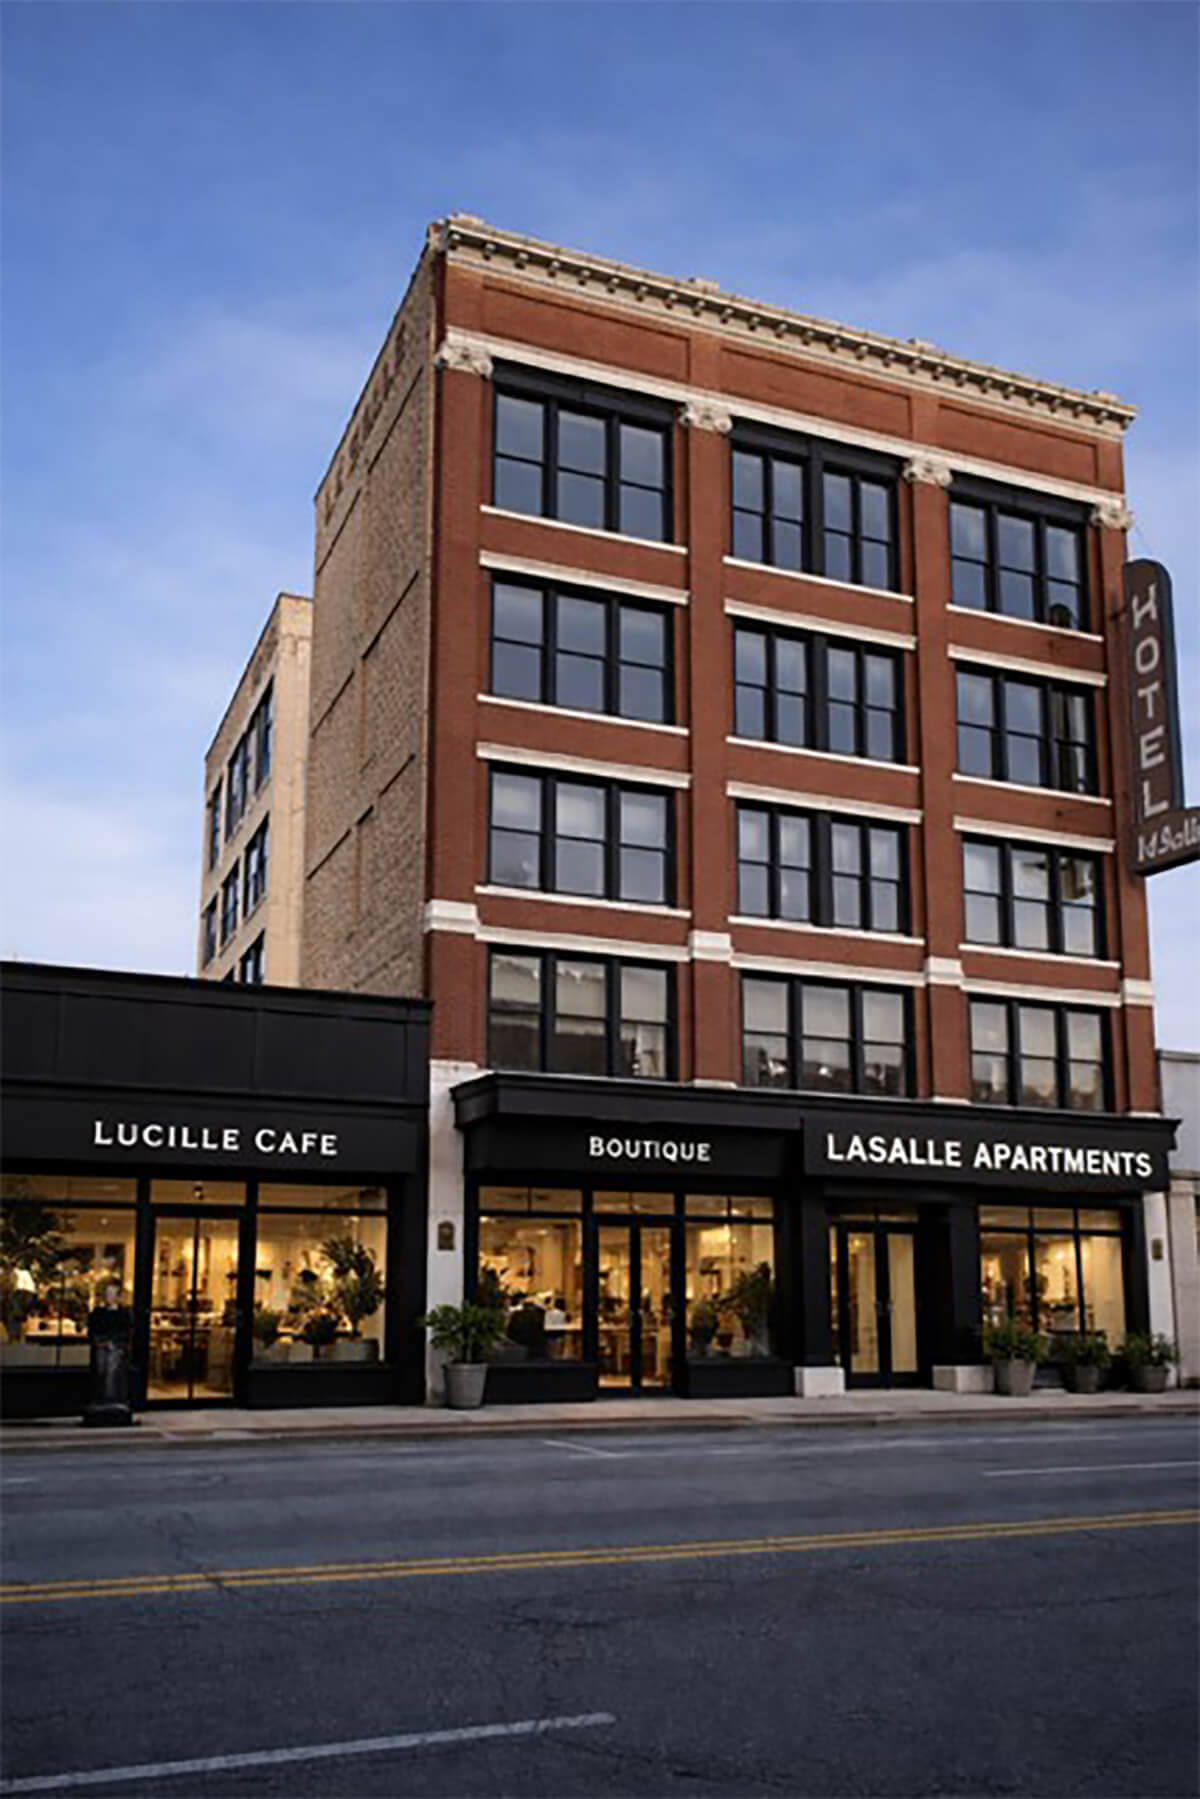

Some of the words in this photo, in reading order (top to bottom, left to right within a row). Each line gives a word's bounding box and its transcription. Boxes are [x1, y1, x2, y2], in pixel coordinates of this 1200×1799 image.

[1132, 583, 1169, 818] HOTEL
[94, 1120, 239, 1151] LUCILLE
[254, 1128, 338, 1157] CAFE
[588, 1136, 712, 1162] BOUTIQUE
[827, 1132, 963, 1168] LASALLE
[973, 1141, 1153, 1179] APARTMENTS
